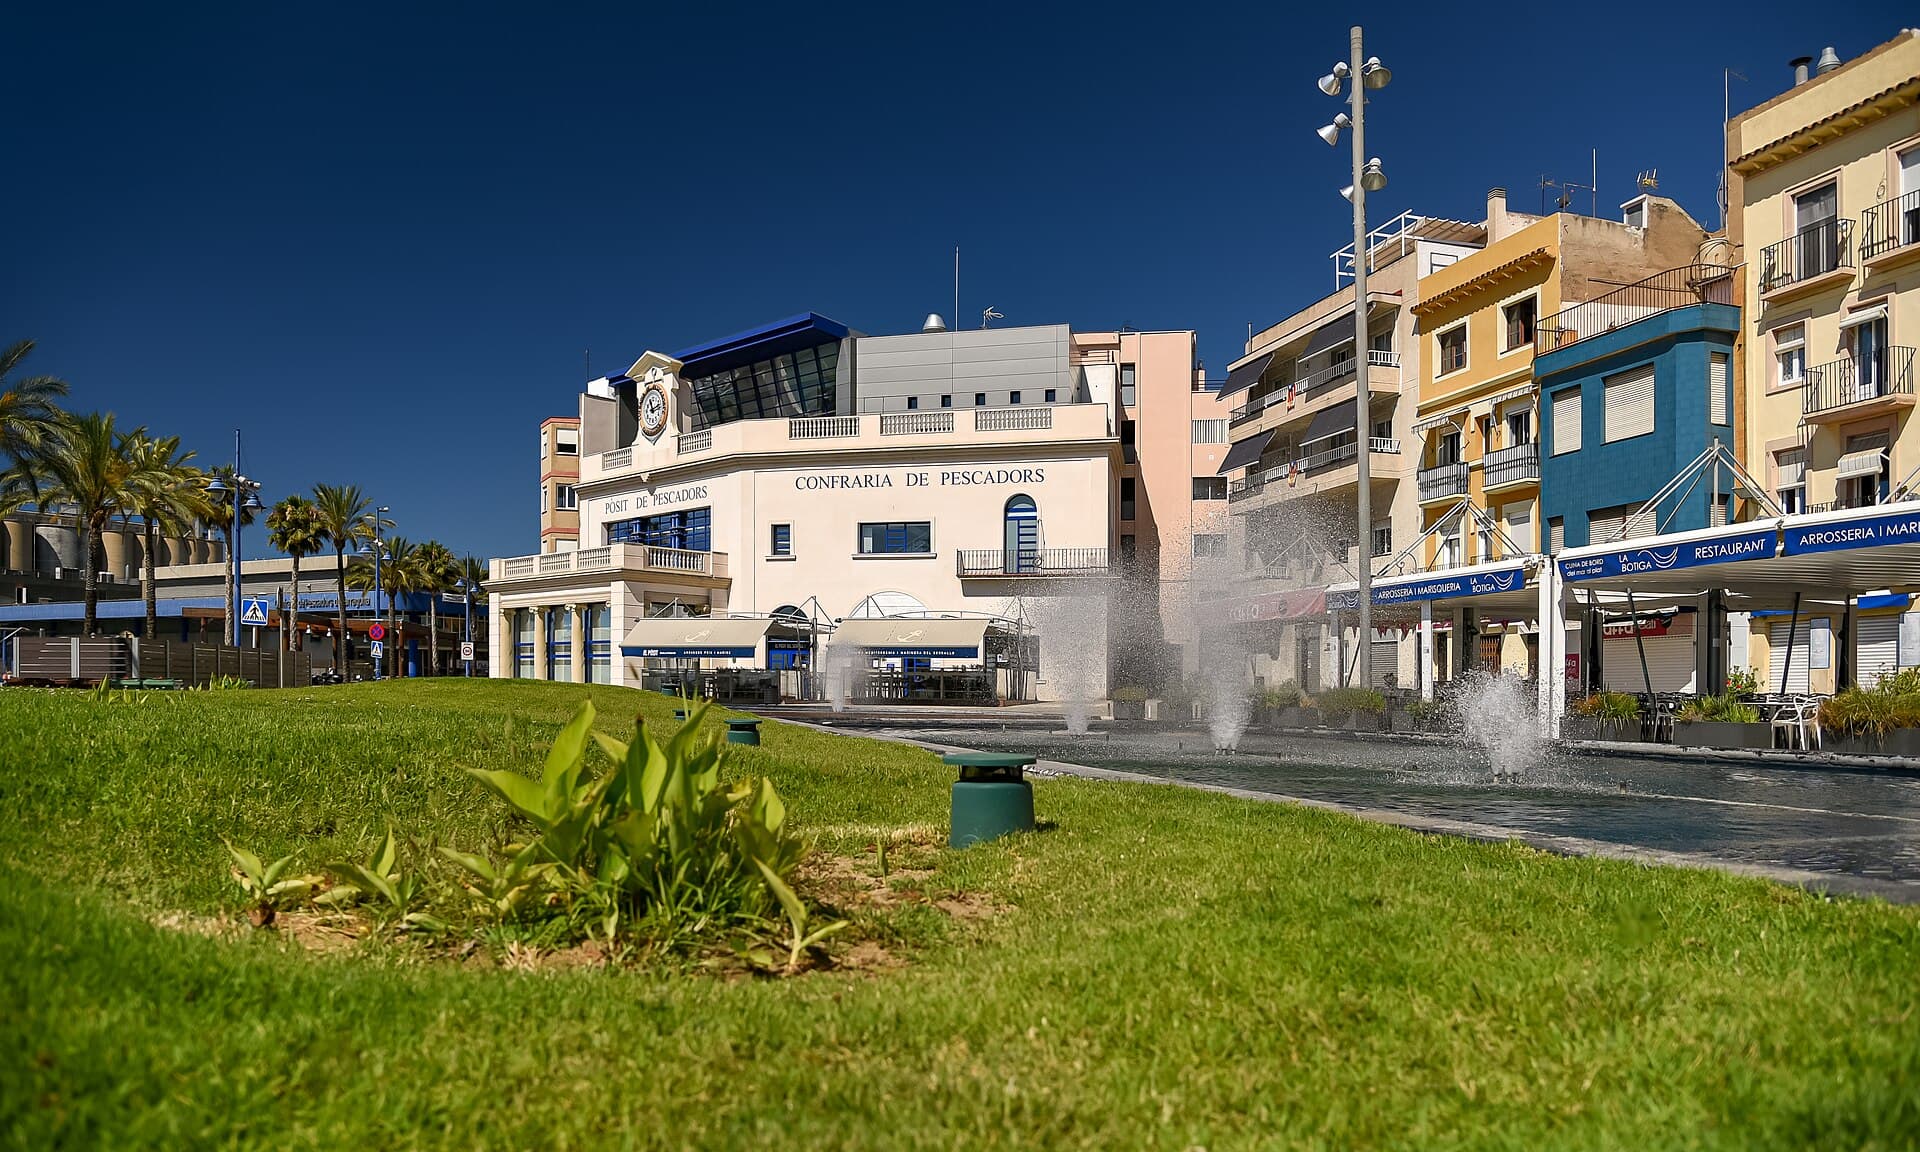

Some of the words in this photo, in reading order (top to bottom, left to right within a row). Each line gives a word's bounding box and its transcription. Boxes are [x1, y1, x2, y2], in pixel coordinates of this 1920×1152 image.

[795, 474, 893, 490] CONFRARIA
[906, 472, 929, 487] DE
[941, 469, 1045, 486] PESCADORS
[636, 495, 648, 509] DE
[653, 485, 708, 507] PESCADORS
[1800, 526, 1875, 546] ARROSSERIA
[1880, 524, 1883, 537] I
[1695, 538, 1766, 560] RESTAURANT
[1581, 560, 1589, 568] DE
[1618, 554, 1628, 563] LA
[1621, 561, 1652, 572] BOTIGA
[1470, 577, 1478, 585] LA
[1472, 583, 1496, 593] BOTIGA
[1377, 587, 1413, 599] ARROSSERIA
[1417, 582, 1462, 595] MARISQUERIA
